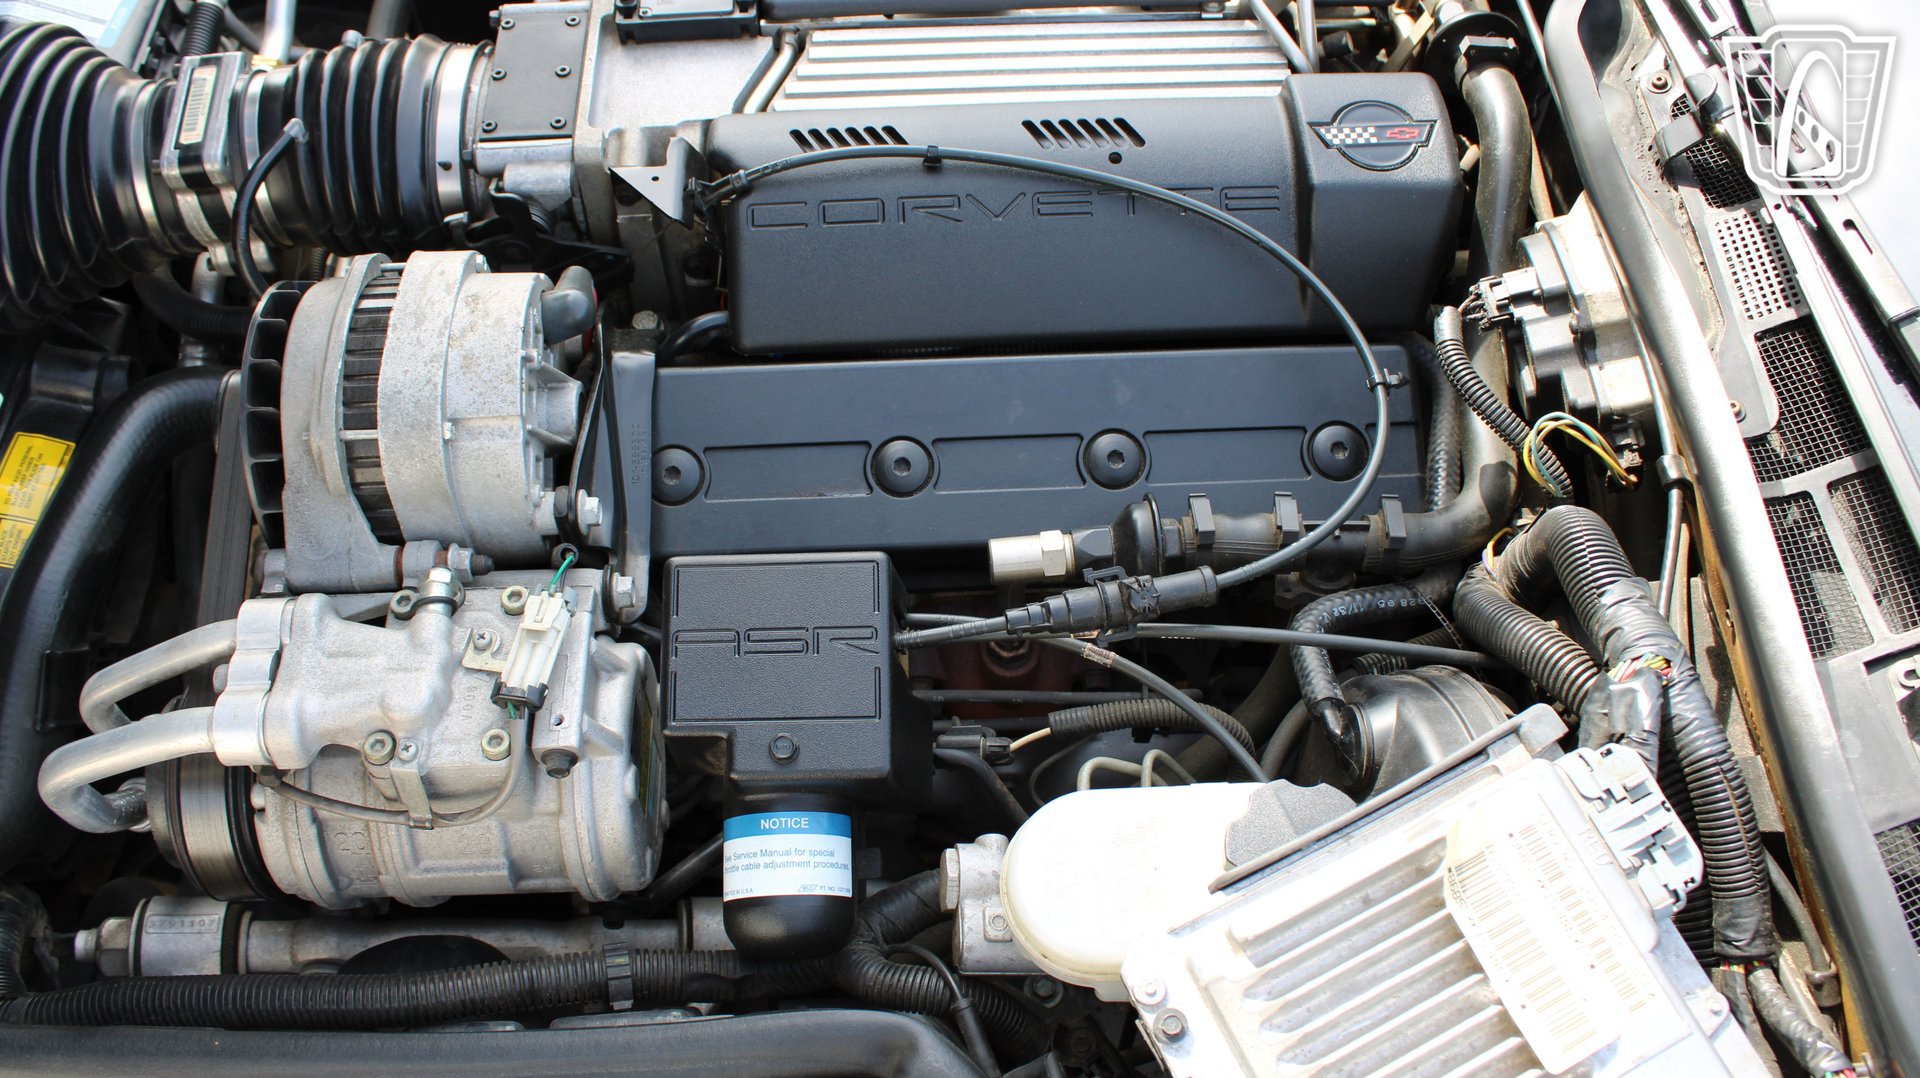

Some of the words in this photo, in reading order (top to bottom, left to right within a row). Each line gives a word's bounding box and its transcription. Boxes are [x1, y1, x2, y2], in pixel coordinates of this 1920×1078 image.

[672, 625, 880, 658] ASR
[760, 818, 809, 829] NOTICE
[734, 850, 757, 860] Service
[760, 848, 791, 857] Manual
[794, 848, 805, 856] for
[809, 849, 835, 858] special
[741, 862, 760, 871] cable
[763, 859, 811, 871] adjustment
